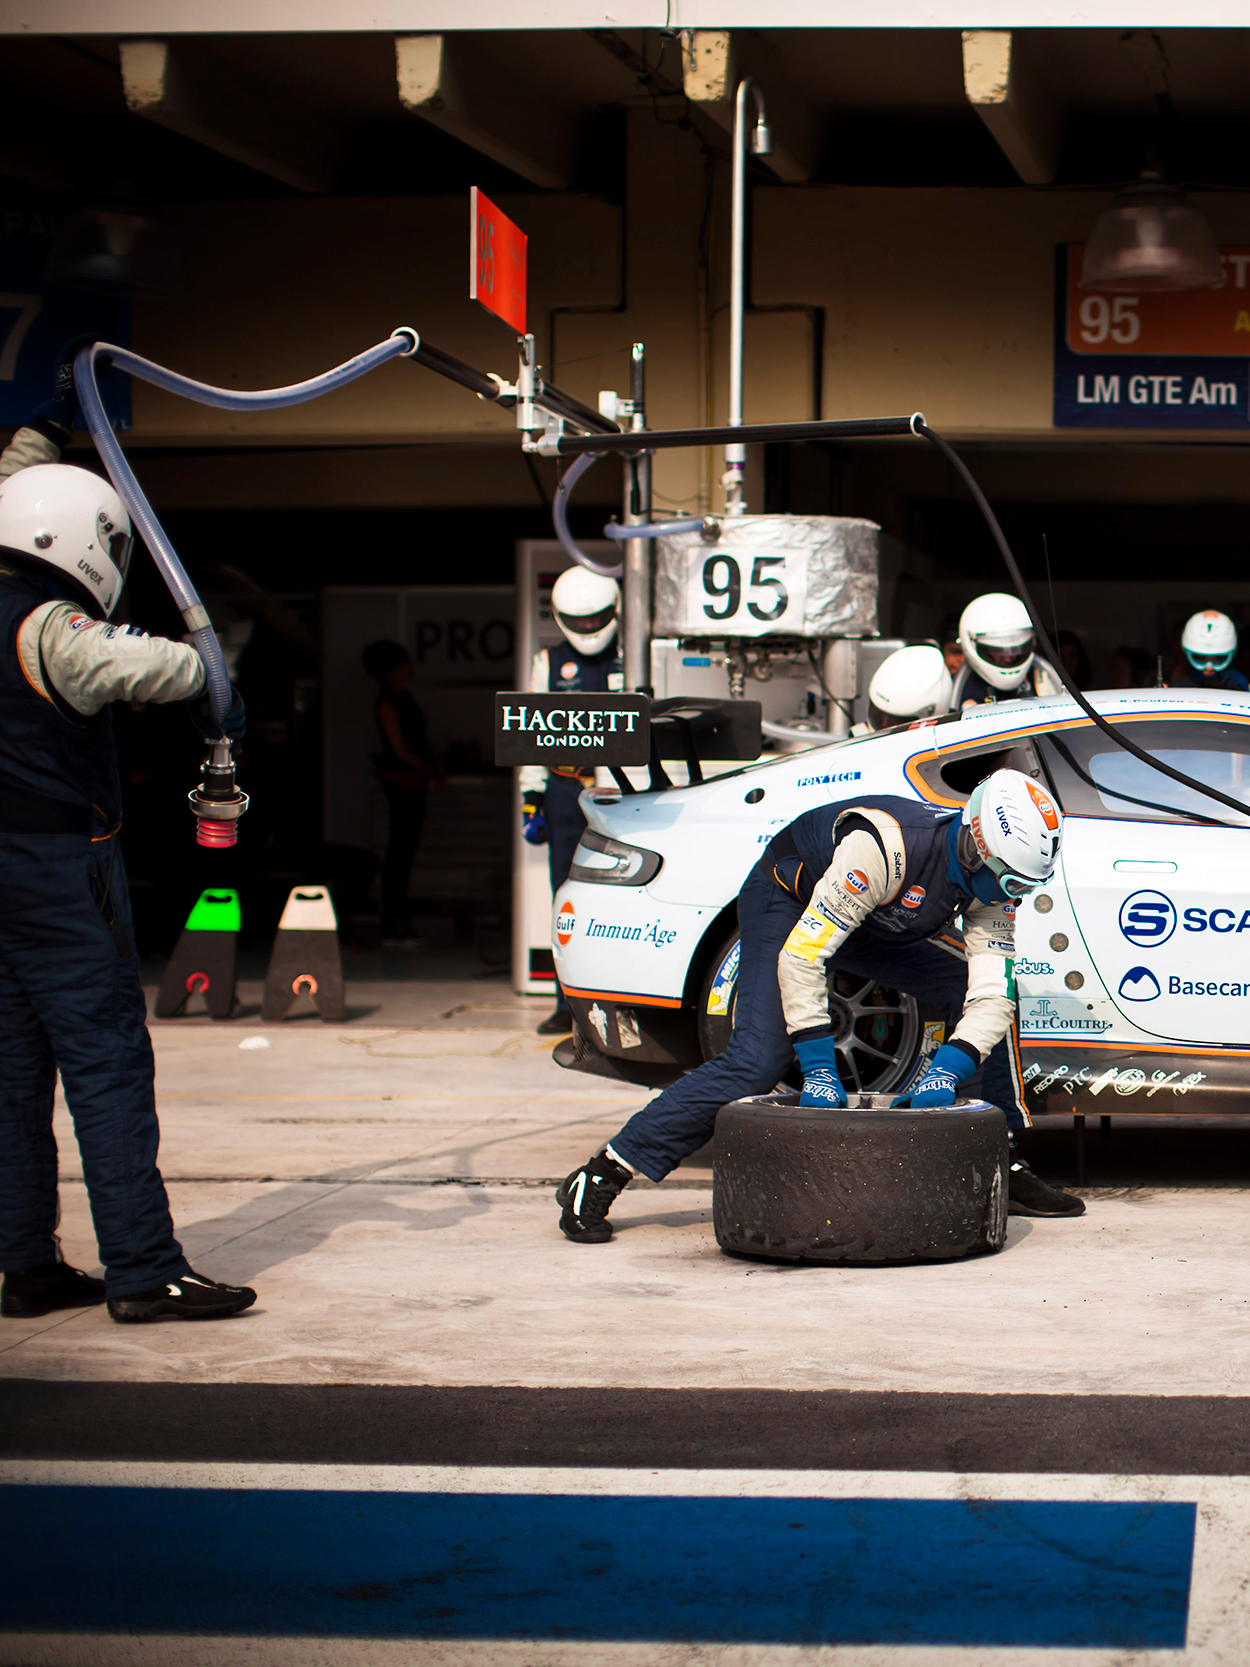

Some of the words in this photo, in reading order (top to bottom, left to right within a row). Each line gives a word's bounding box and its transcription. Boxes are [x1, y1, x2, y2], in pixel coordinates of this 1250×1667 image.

[479, 213, 495, 295] 95
[1079, 295, 1142, 344] 95
[1076, 374, 1121, 404] LM
[1128, 375, 1184, 406] GTE
[1188, 375, 1238, 406] Am
[76, 559, 105, 586] uvex
[701, 554, 790, 622] 95
[416, 620, 514, 661] PRO
[502, 705, 640, 733] HACKETT
[536, 734, 605, 747] LONDON
[995, 806, 1013, 837] uvex
[971, 816, 993, 862] uvex
[846, 871, 868, 893] Gulf
[556, 916, 576, 931] Gulf
[1033, 1065, 1070, 1094] RECARO
